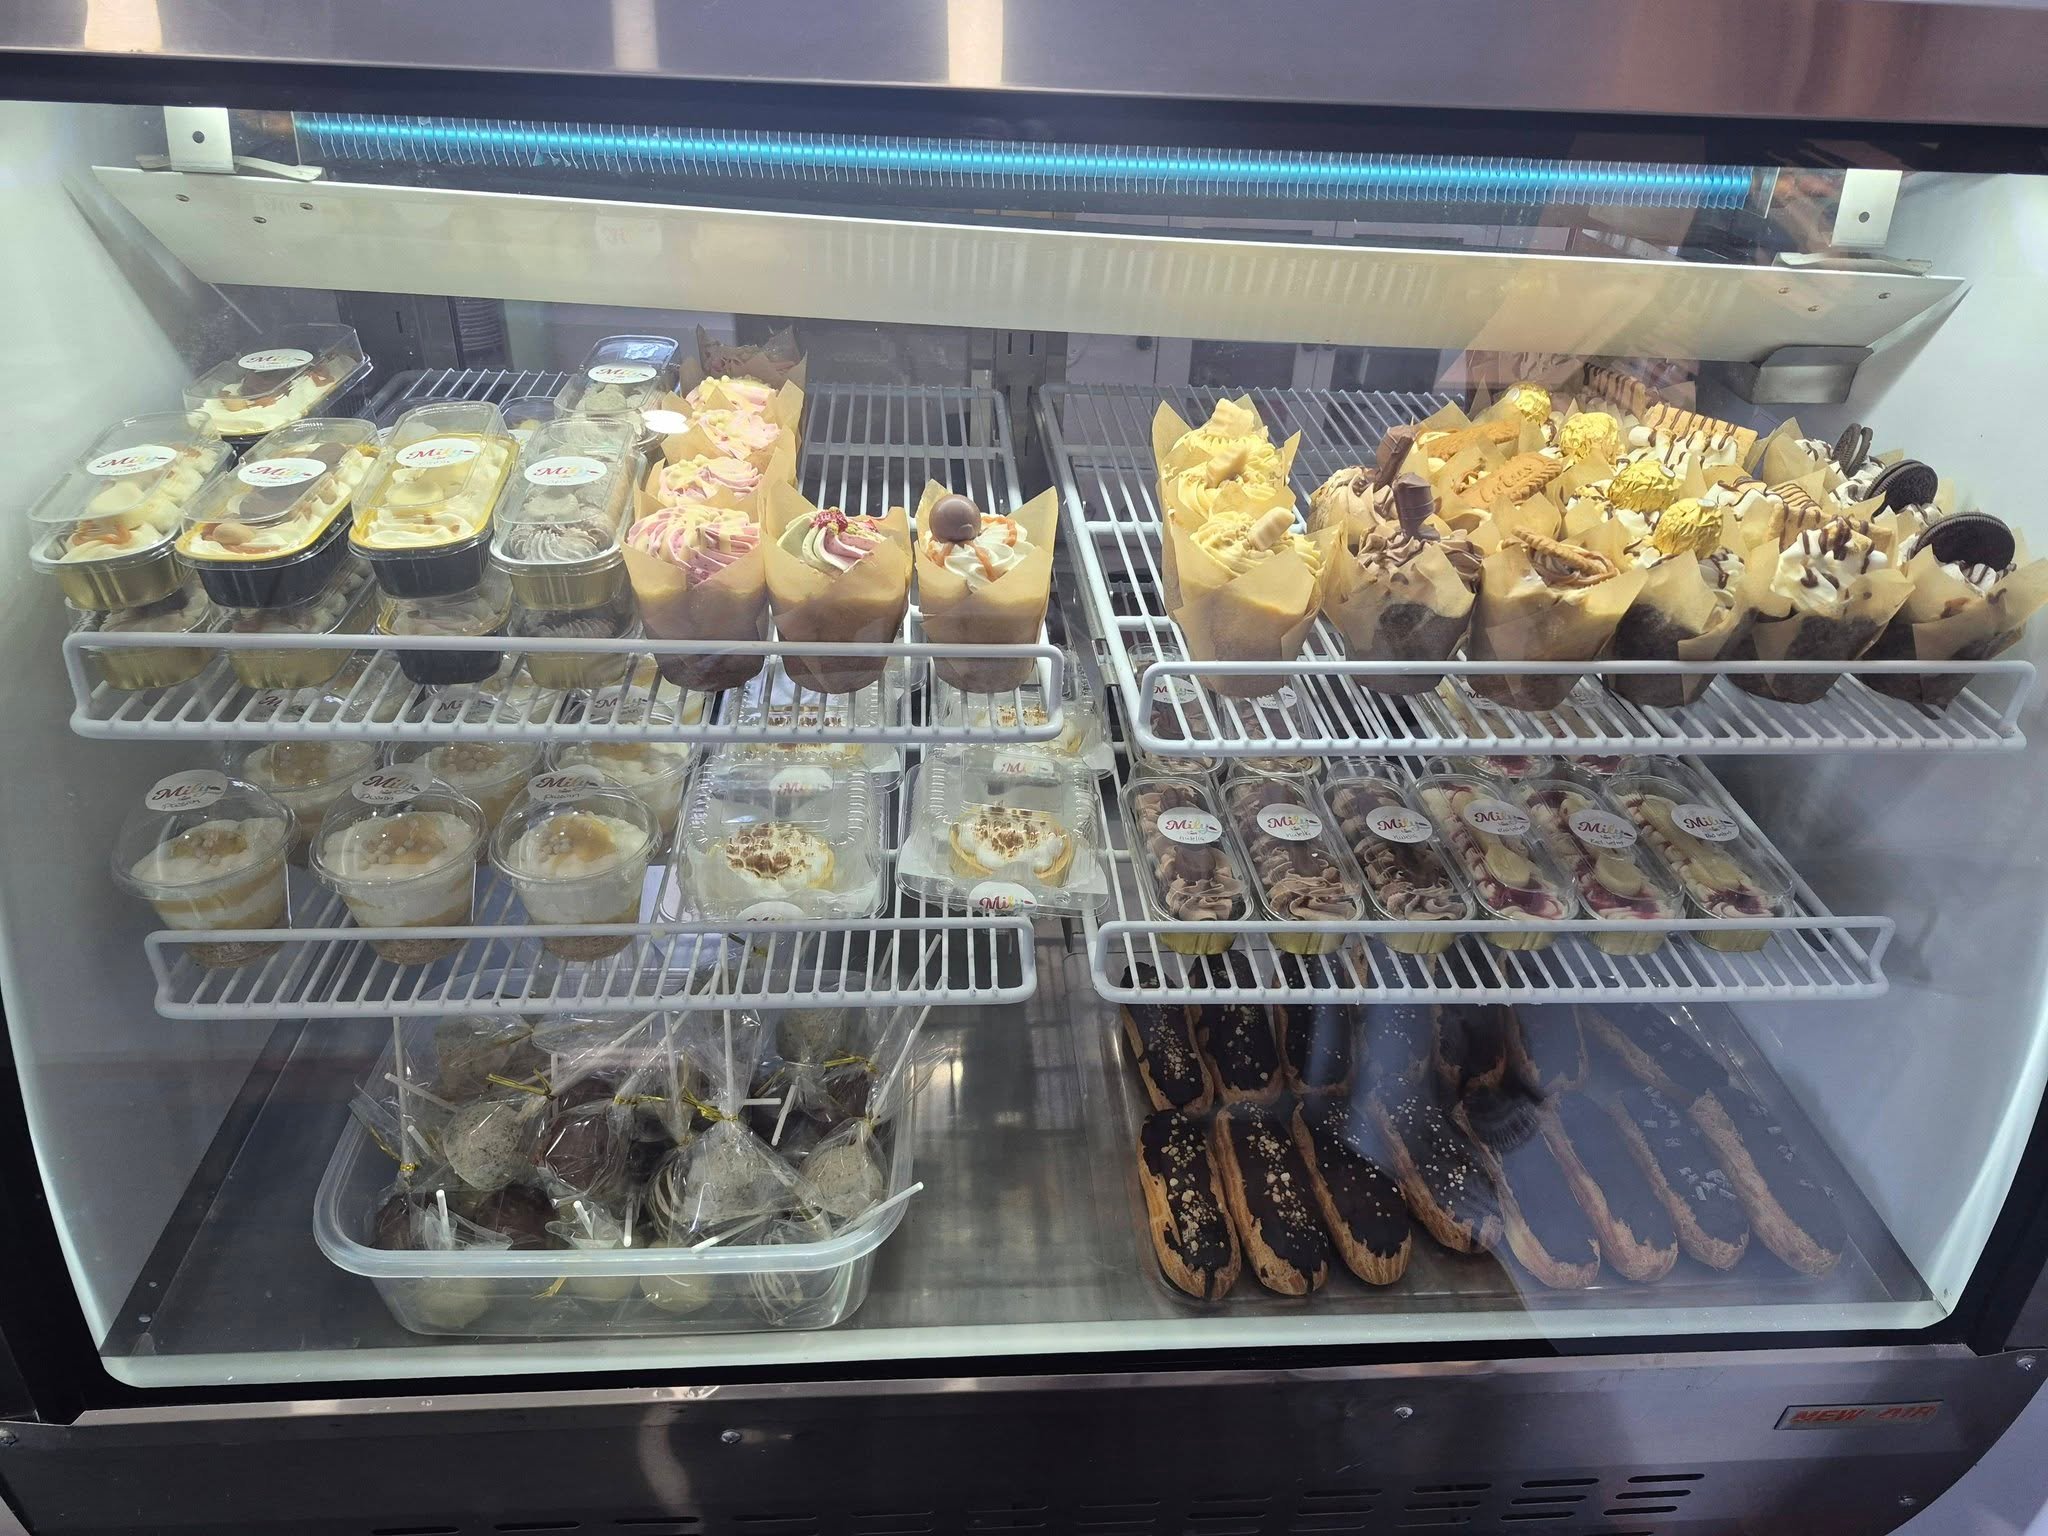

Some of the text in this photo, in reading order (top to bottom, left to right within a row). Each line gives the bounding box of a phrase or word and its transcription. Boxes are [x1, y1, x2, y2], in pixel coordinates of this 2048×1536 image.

[1165, 819, 1218, 835] Mily
[1267, 816, 1320, 830] Mily
[1790, 1405, 1938, 1424] NEW AIR
